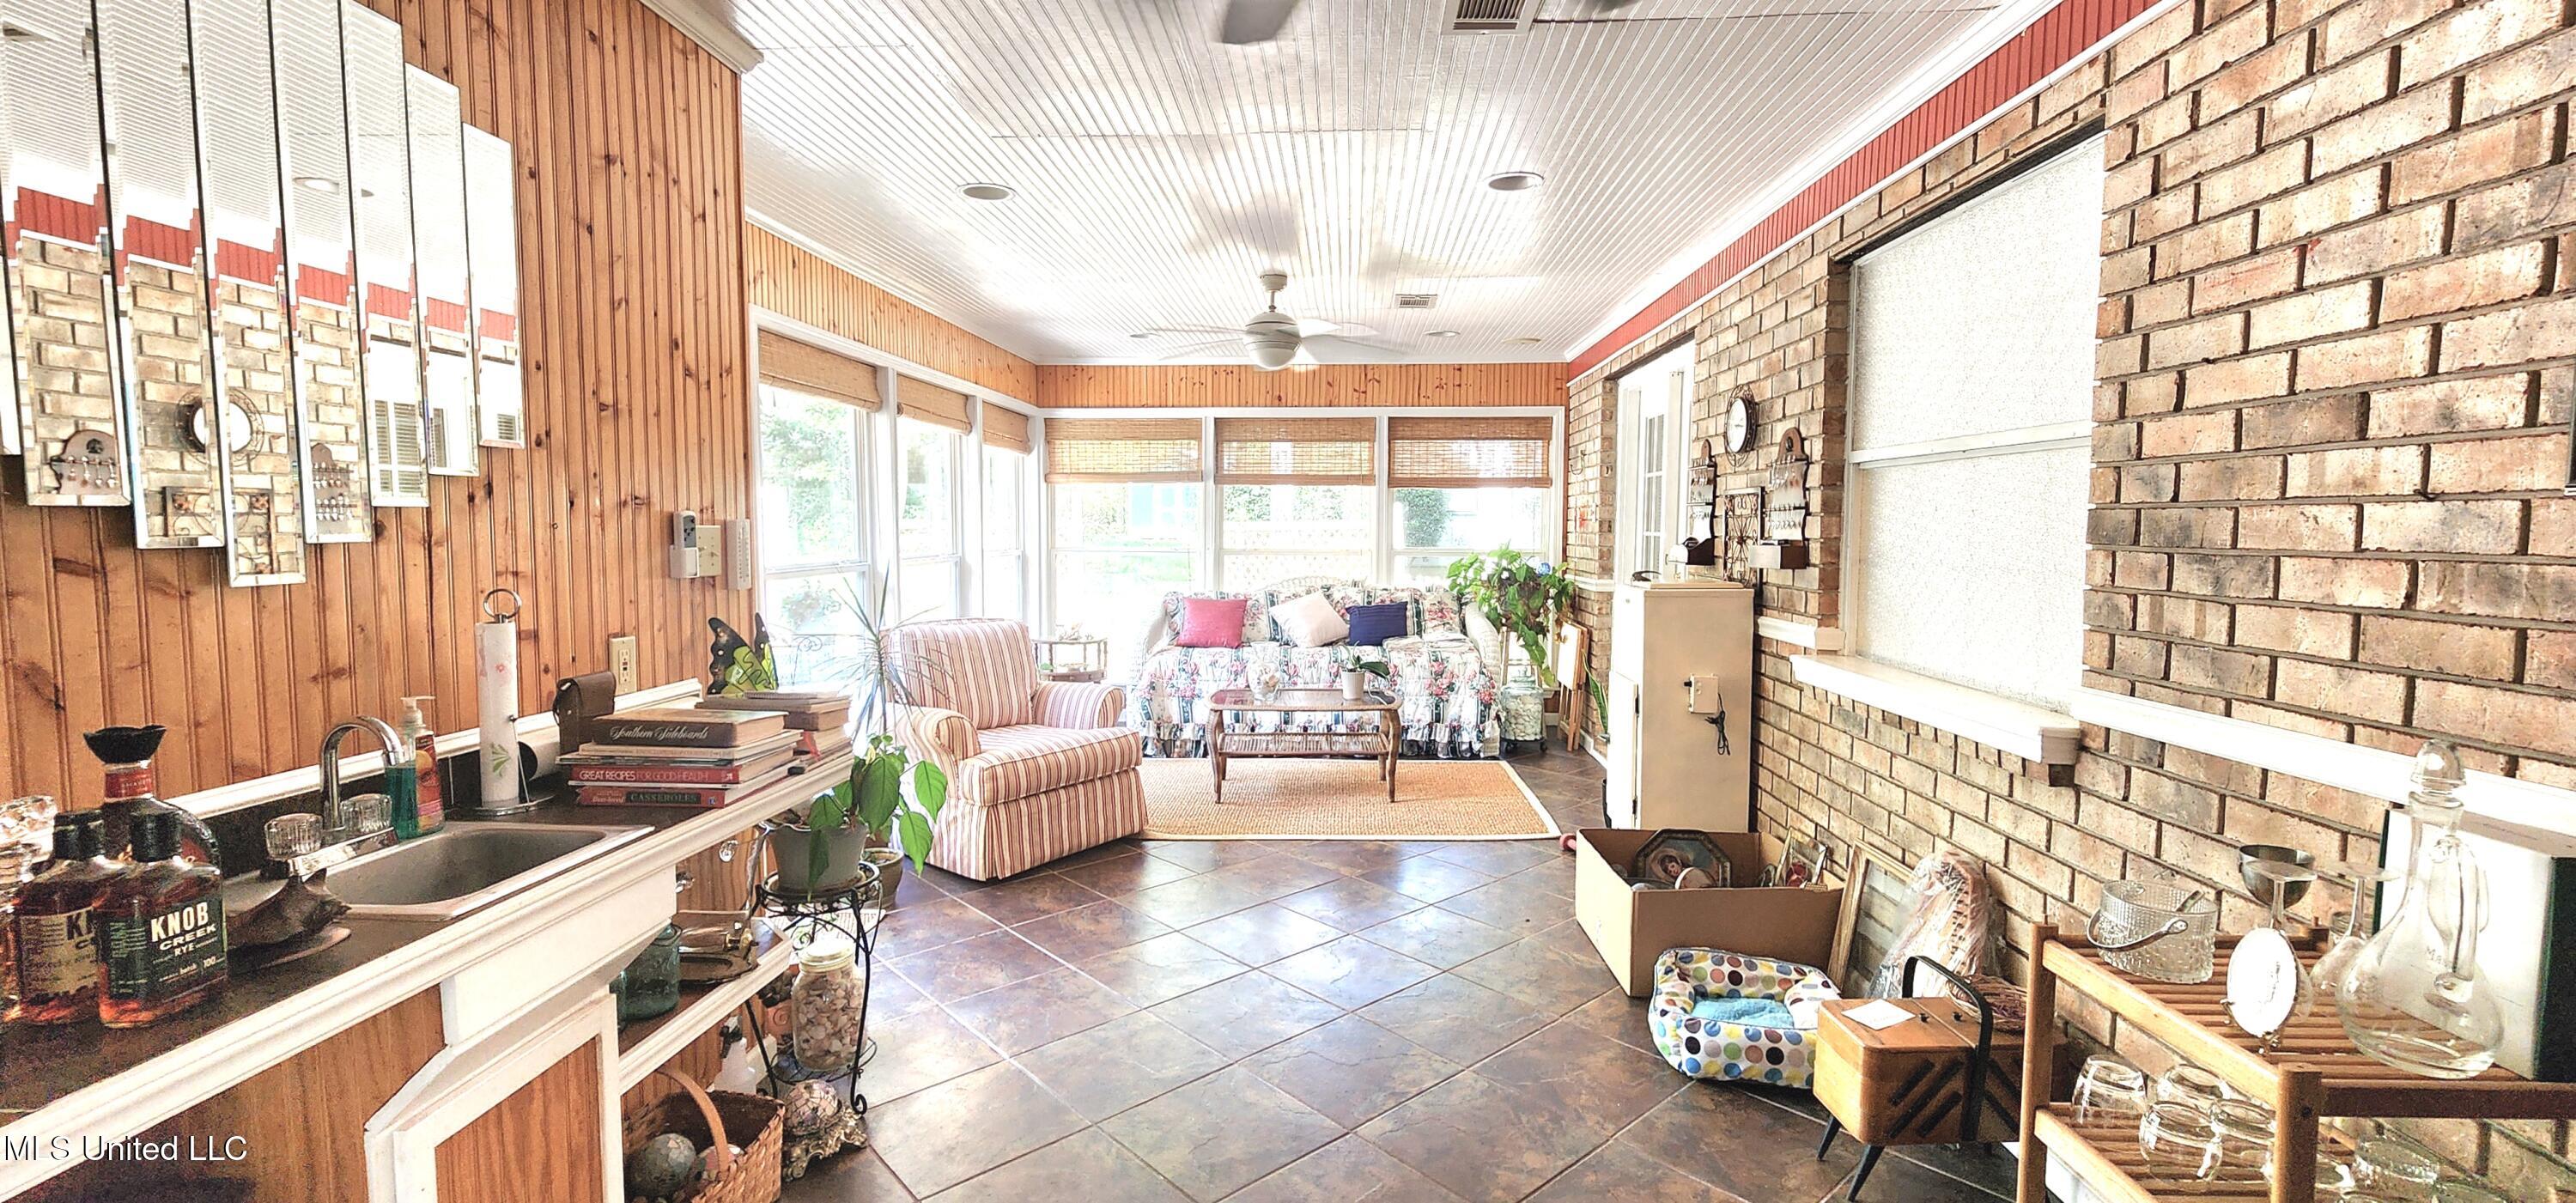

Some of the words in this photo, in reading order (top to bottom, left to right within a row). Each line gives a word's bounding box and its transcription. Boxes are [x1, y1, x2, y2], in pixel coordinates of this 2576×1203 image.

[611, 726, 653, 741] Southern
[654, 725, 709, 741] Sideboards
[580, 769, 605, 781] GREAT
[605, 770, 635, 781] RECIPES
[636, 771, 653, 781] FOR
[653, 771, 677, 781] GOOD
[677, 771, 708, 781] HEALTH
[630, 793, 697, 804] CASSEROLES
[150, 902, 209, 942] KNOB
[159, 923, 216, 951] CREEK
[174, 943, 195, 957] RYE
